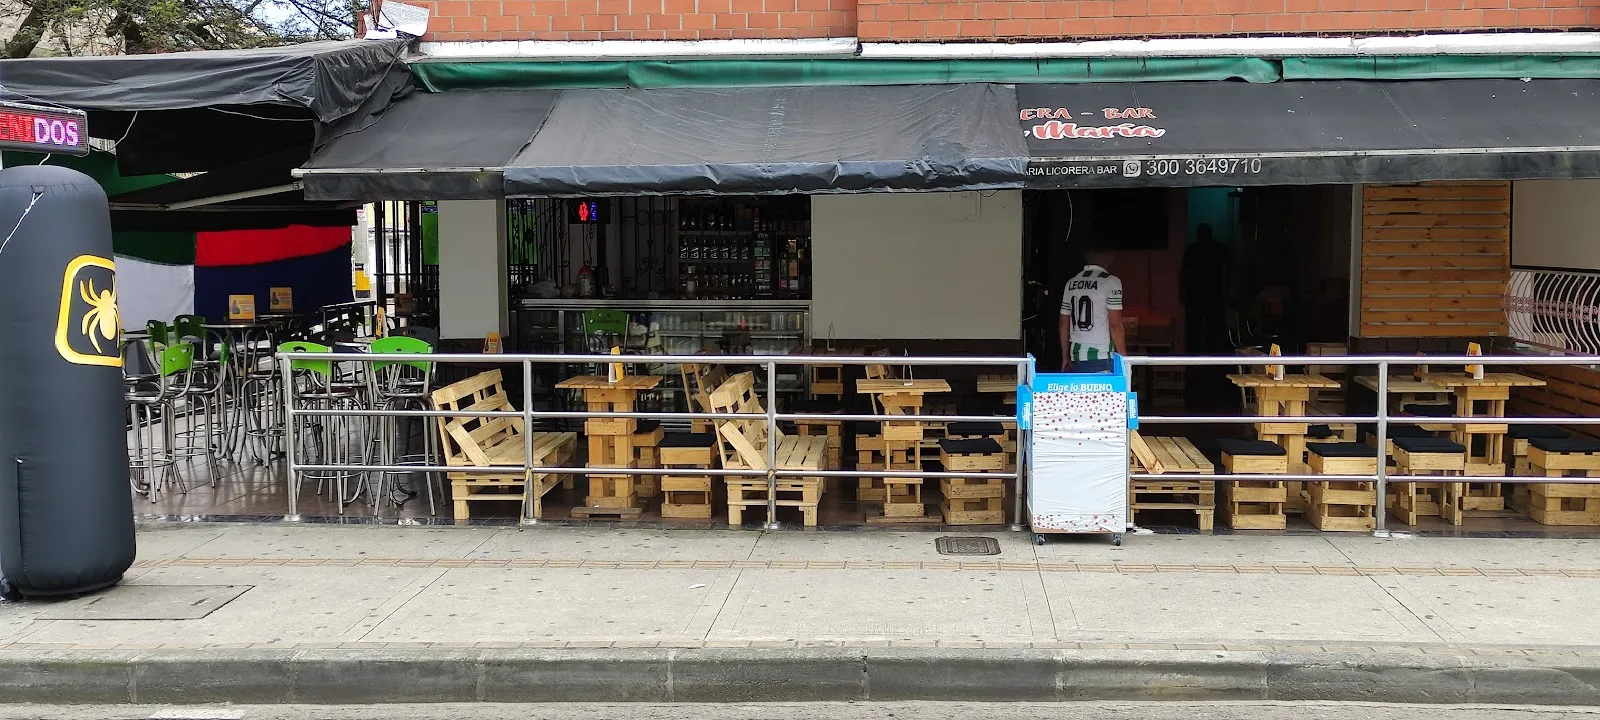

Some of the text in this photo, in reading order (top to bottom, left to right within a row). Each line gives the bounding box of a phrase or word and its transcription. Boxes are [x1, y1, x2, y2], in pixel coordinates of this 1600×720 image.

[1020, 108, 1072, 120] ERA
[1102, 108, 1156, 120] BAR
[1046, 166, 1095, 176] LICORERA
[1097, 165, 1118, 175] BAR
[1146, 159, 1180, 176] 300
[1185, 158, 1262, 175] 3649710
[1069, 281, 1098, 291] LEONA
[1071, 296, 1094, 331] 10
[1047, 383, 1069, 393] Elige
[1070, 383, 1079, 392] lo
